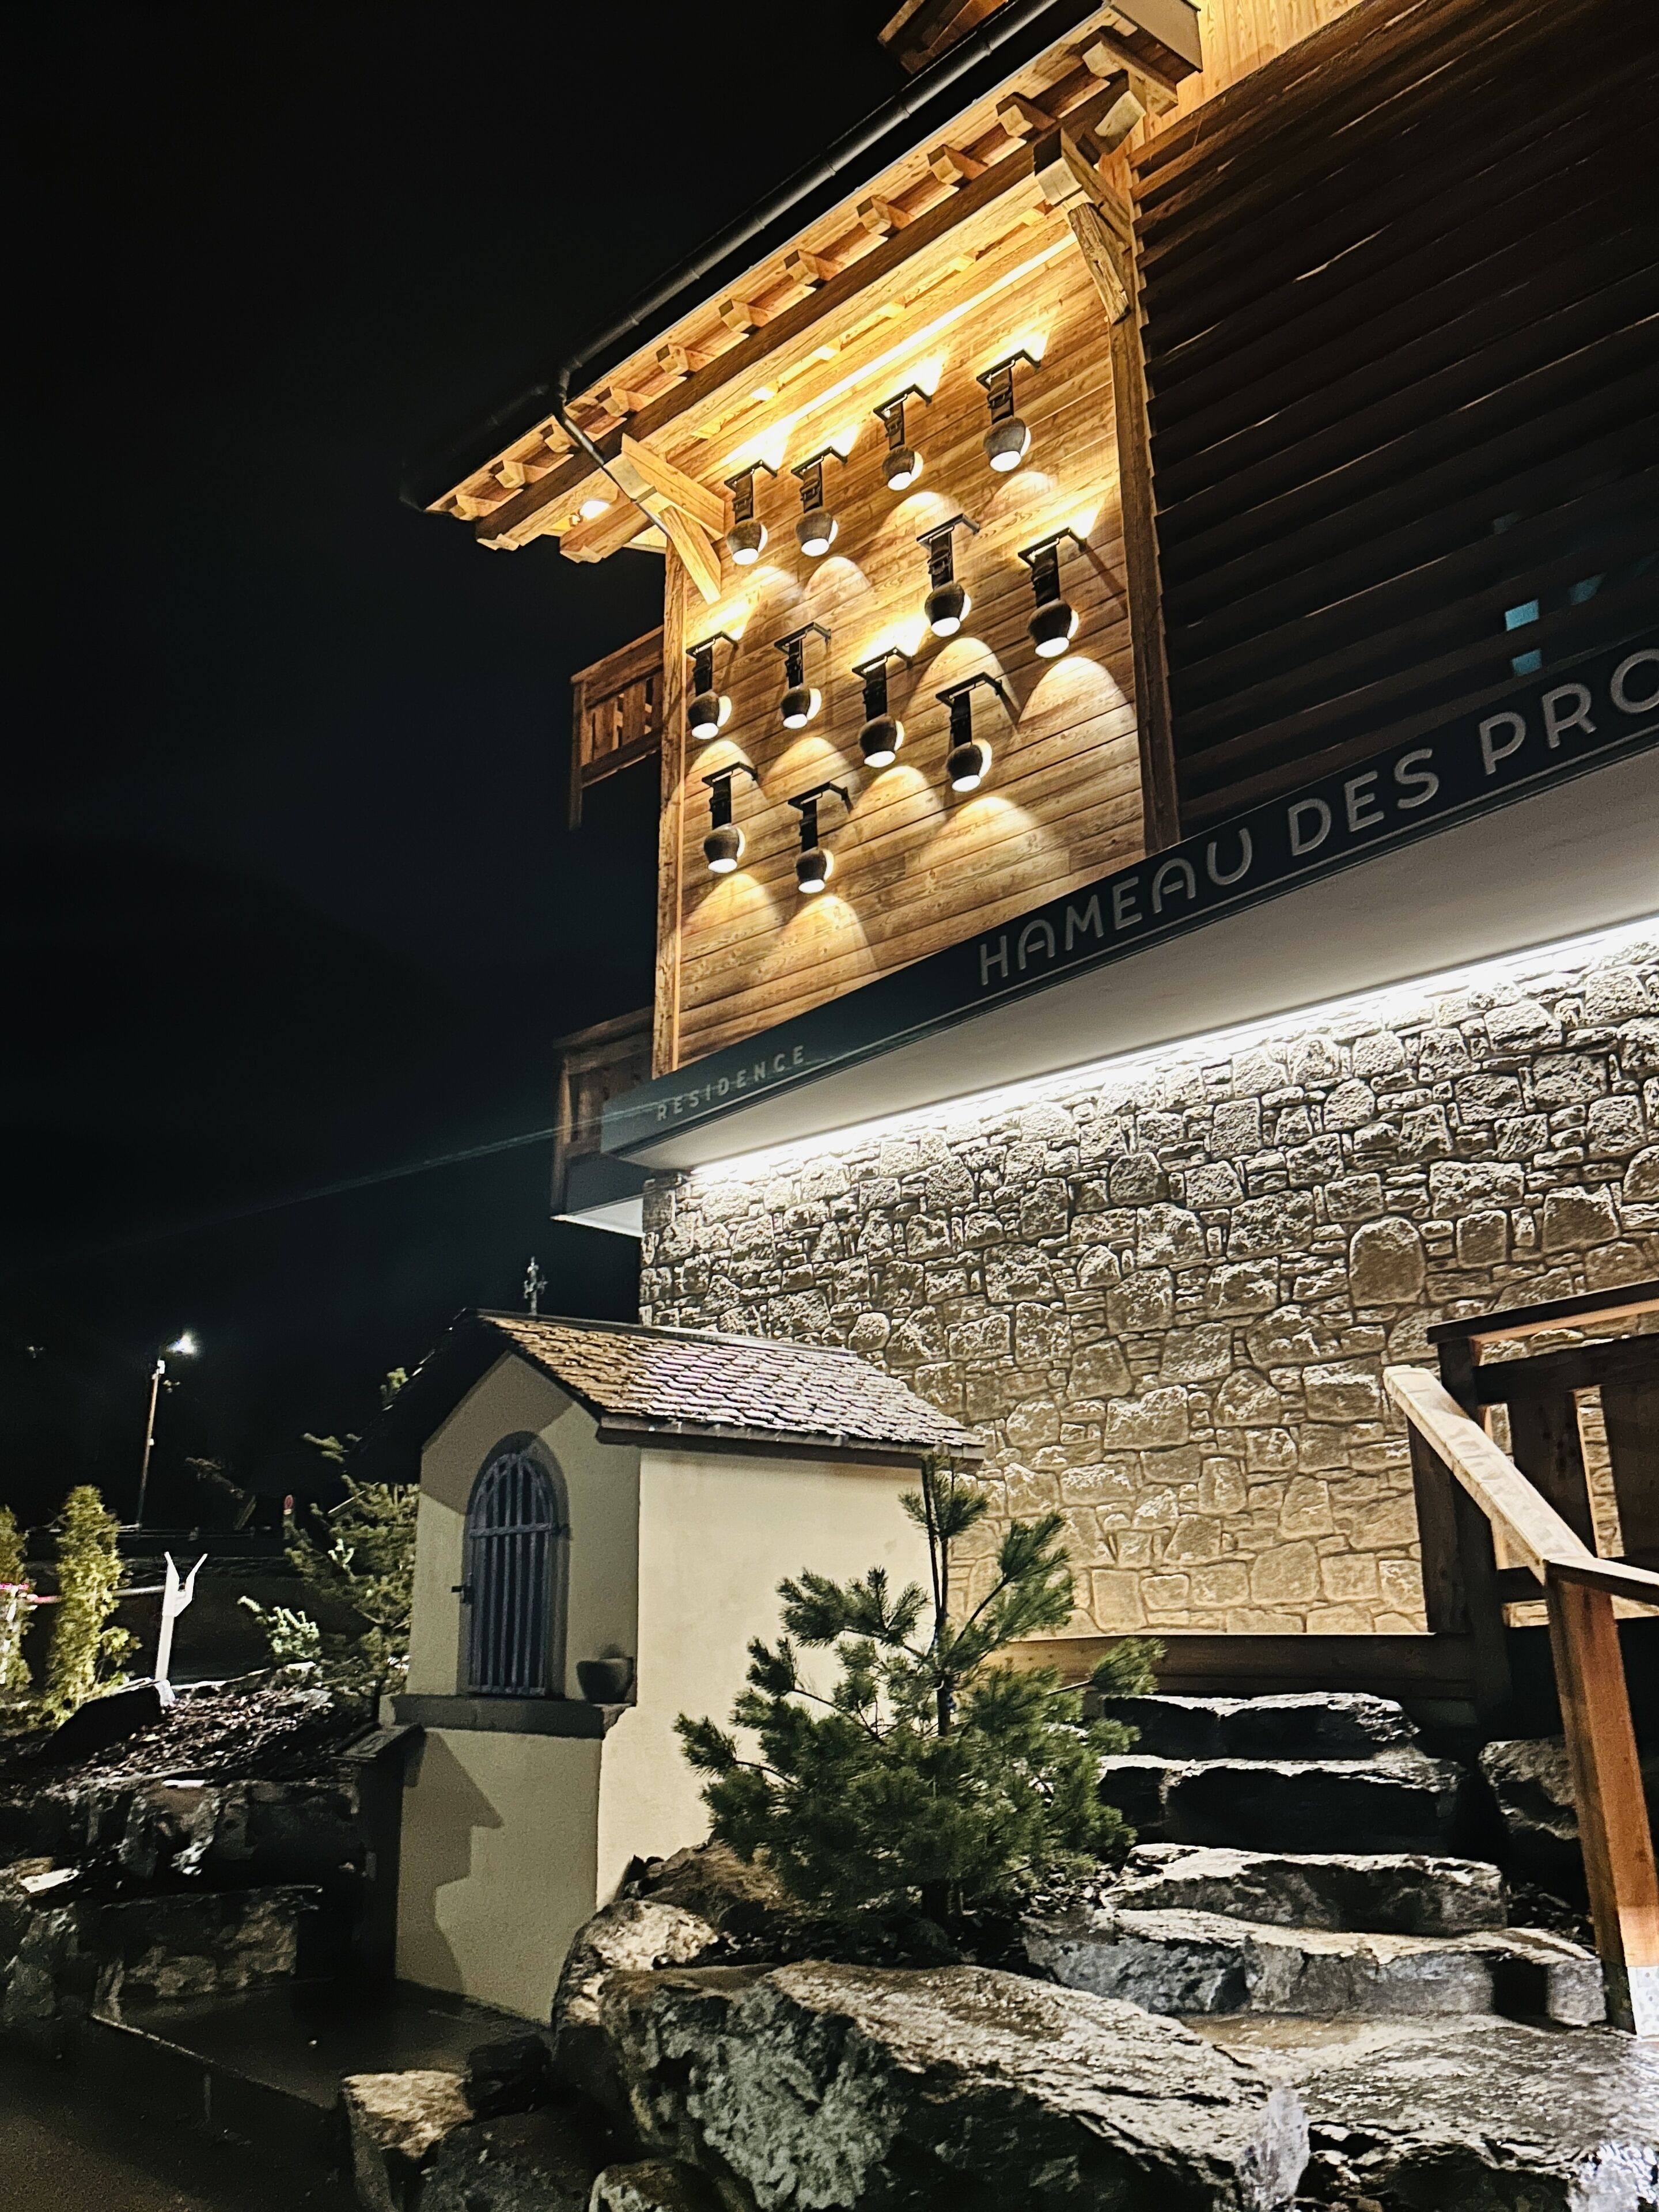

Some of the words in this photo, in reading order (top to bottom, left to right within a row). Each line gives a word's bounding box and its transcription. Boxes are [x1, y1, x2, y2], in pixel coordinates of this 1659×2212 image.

[979, 827, 1253, 986] HAMEAU
[1287, 747, 1440, 857] DES
[1478, 649, 1659, 776] PRO
[656, 1045, 804, 1122] RESIDENCE
